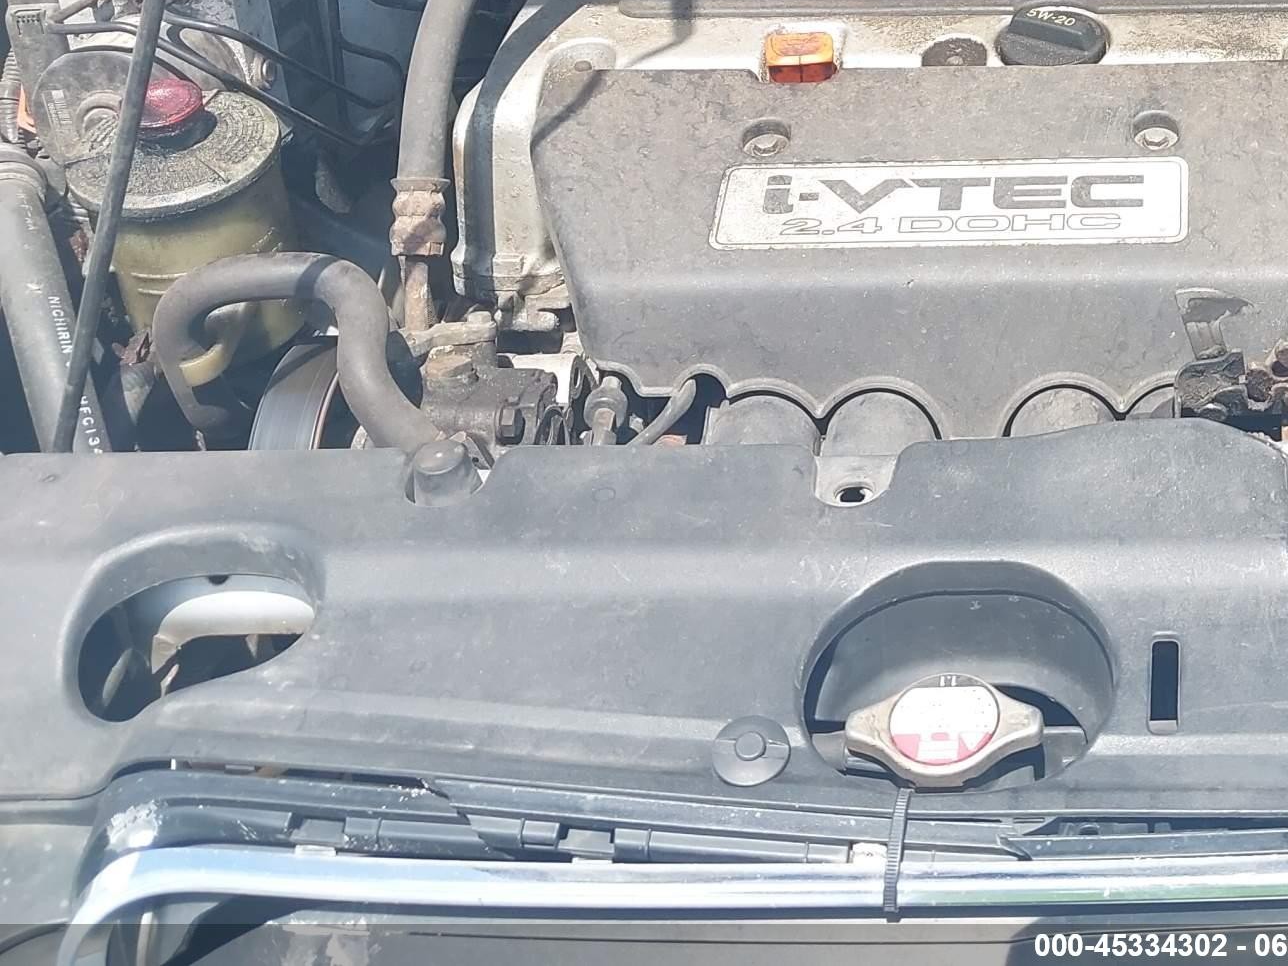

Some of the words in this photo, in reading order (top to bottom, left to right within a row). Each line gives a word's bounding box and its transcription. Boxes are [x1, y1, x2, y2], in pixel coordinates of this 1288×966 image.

[1026, 8, 1077, 27] 5W-20
[762, 174, 1145, 215] i-VTEC
[780, 217, 883, 236] 2.4
[897, 213, 1122, 234] DOHC
[47, 296, 73, 355] NICHIRIN
[939, 675, 957, 687] 1.1
